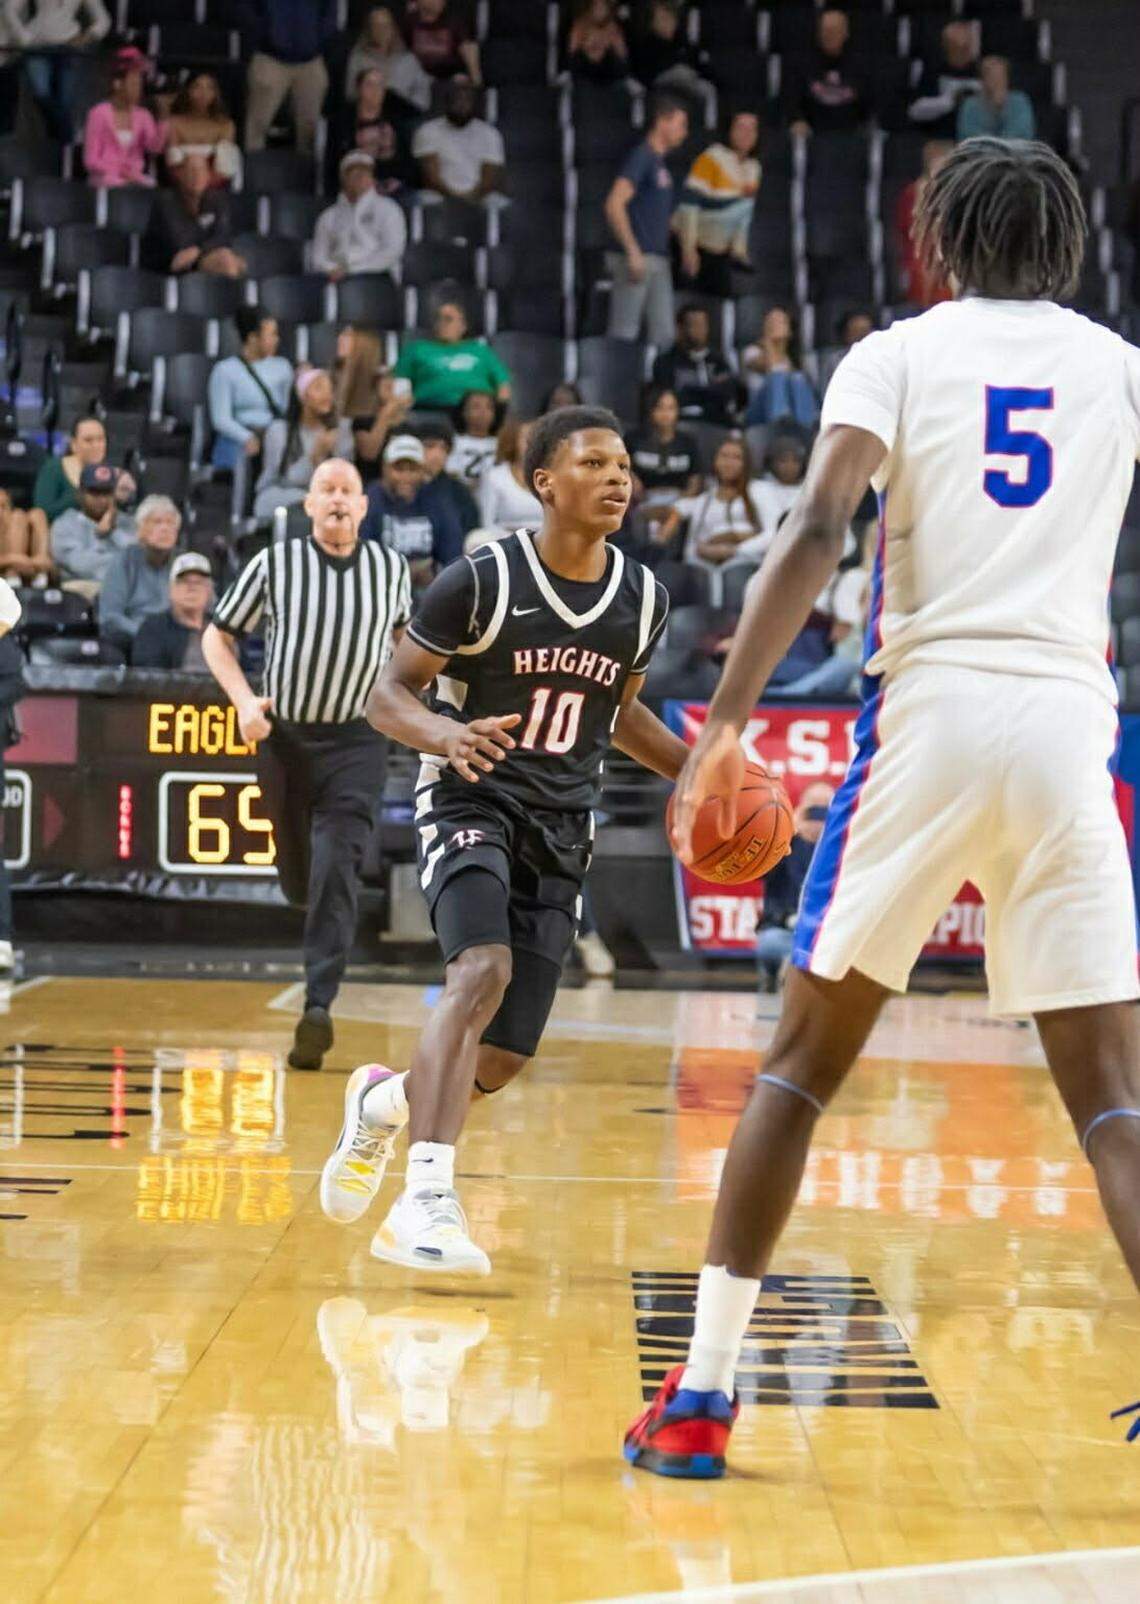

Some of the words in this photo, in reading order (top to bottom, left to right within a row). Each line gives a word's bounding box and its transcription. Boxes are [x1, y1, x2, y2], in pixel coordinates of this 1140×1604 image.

[983, 384, 1055, 508] 5
[512, 646, 621, 686] HEIGHTS
[149, 703, 258, 755] EAGL
[520, 686, 586, 755] 10
[188, 784, 277, 865] 65
